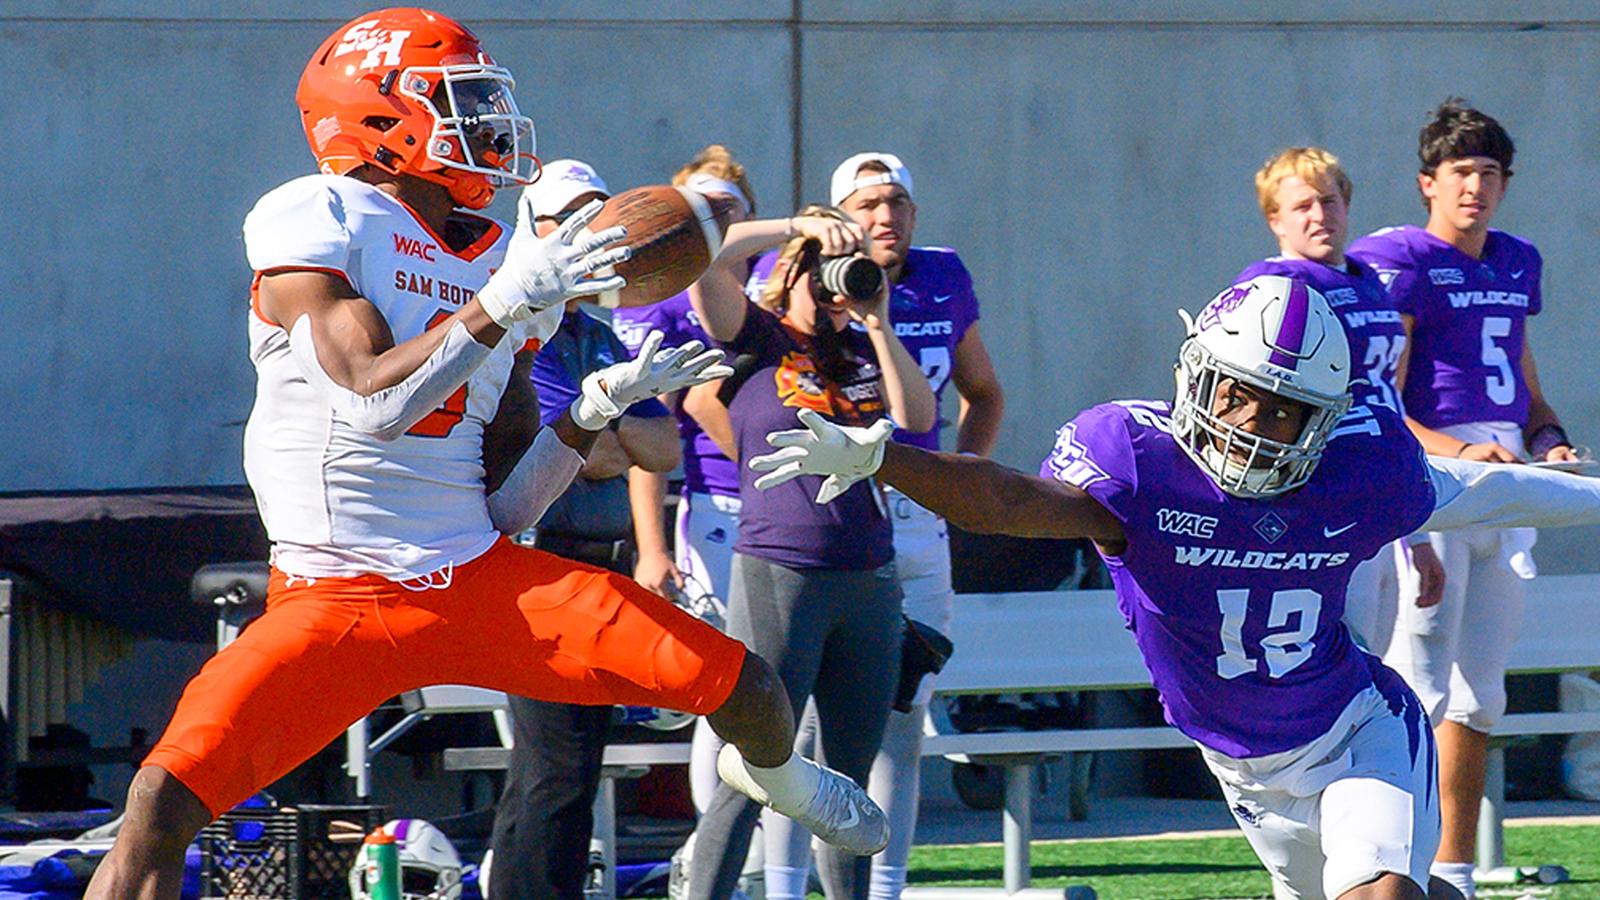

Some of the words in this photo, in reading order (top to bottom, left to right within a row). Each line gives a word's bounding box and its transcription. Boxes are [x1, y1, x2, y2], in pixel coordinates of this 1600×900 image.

[393, 232, 437, 262] WAC
[394, 270, 433, 298] SAM
[1482, 316, 1516, 406] 5
[1156, 508, 1219, 539] WAC
[1174, 545, 1350, 571] WILDCATS
[1215, 587, 1323, 681] 12
